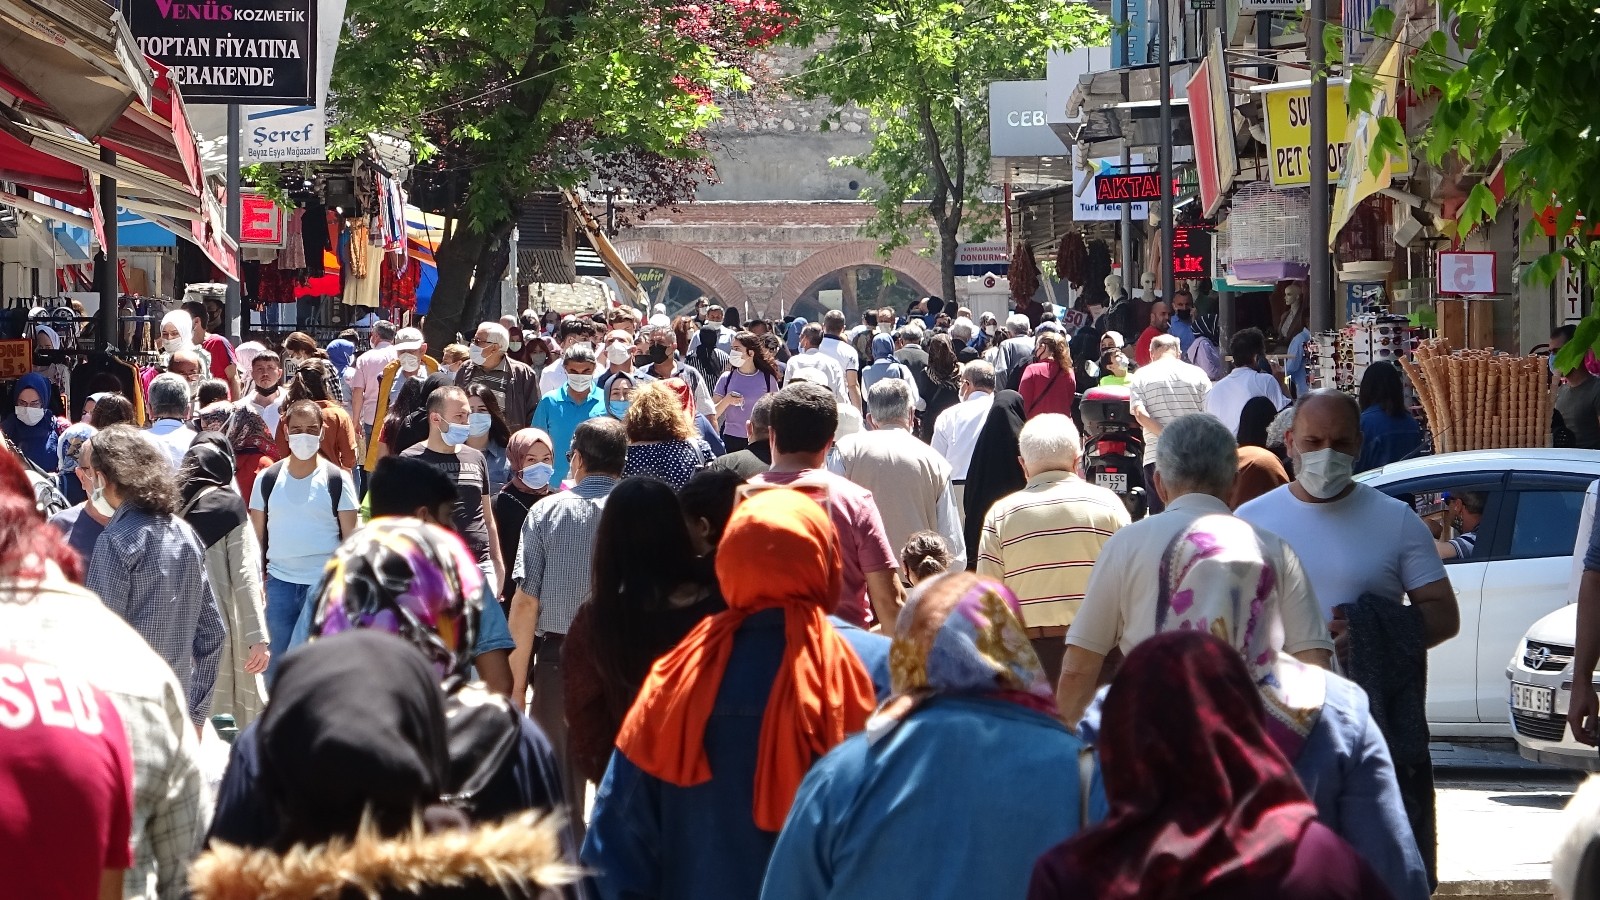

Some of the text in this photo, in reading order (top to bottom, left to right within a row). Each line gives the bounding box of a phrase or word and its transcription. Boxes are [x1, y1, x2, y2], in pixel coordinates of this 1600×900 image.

[155, 0, 305, 22] VENÜS KOZMETİK
[137, 33, 301, 59] TOPTAN FİYATINA
[168, 65, 275, 87] ERAKENDE
[253, 123, 314, 147] Şeref
[248, 146, 321, 160] Beyaz Eşya Mağazaları
[1276, 146, 1303, 178] PET
[1080, 203, 1099, 211] Türk
[241, 199, 274, 239] E
[1065, 310, 1084, 327] 50
[1098, 474, 1125, 482] 16 LSC
[1109, 482, 1119, 490] 77
